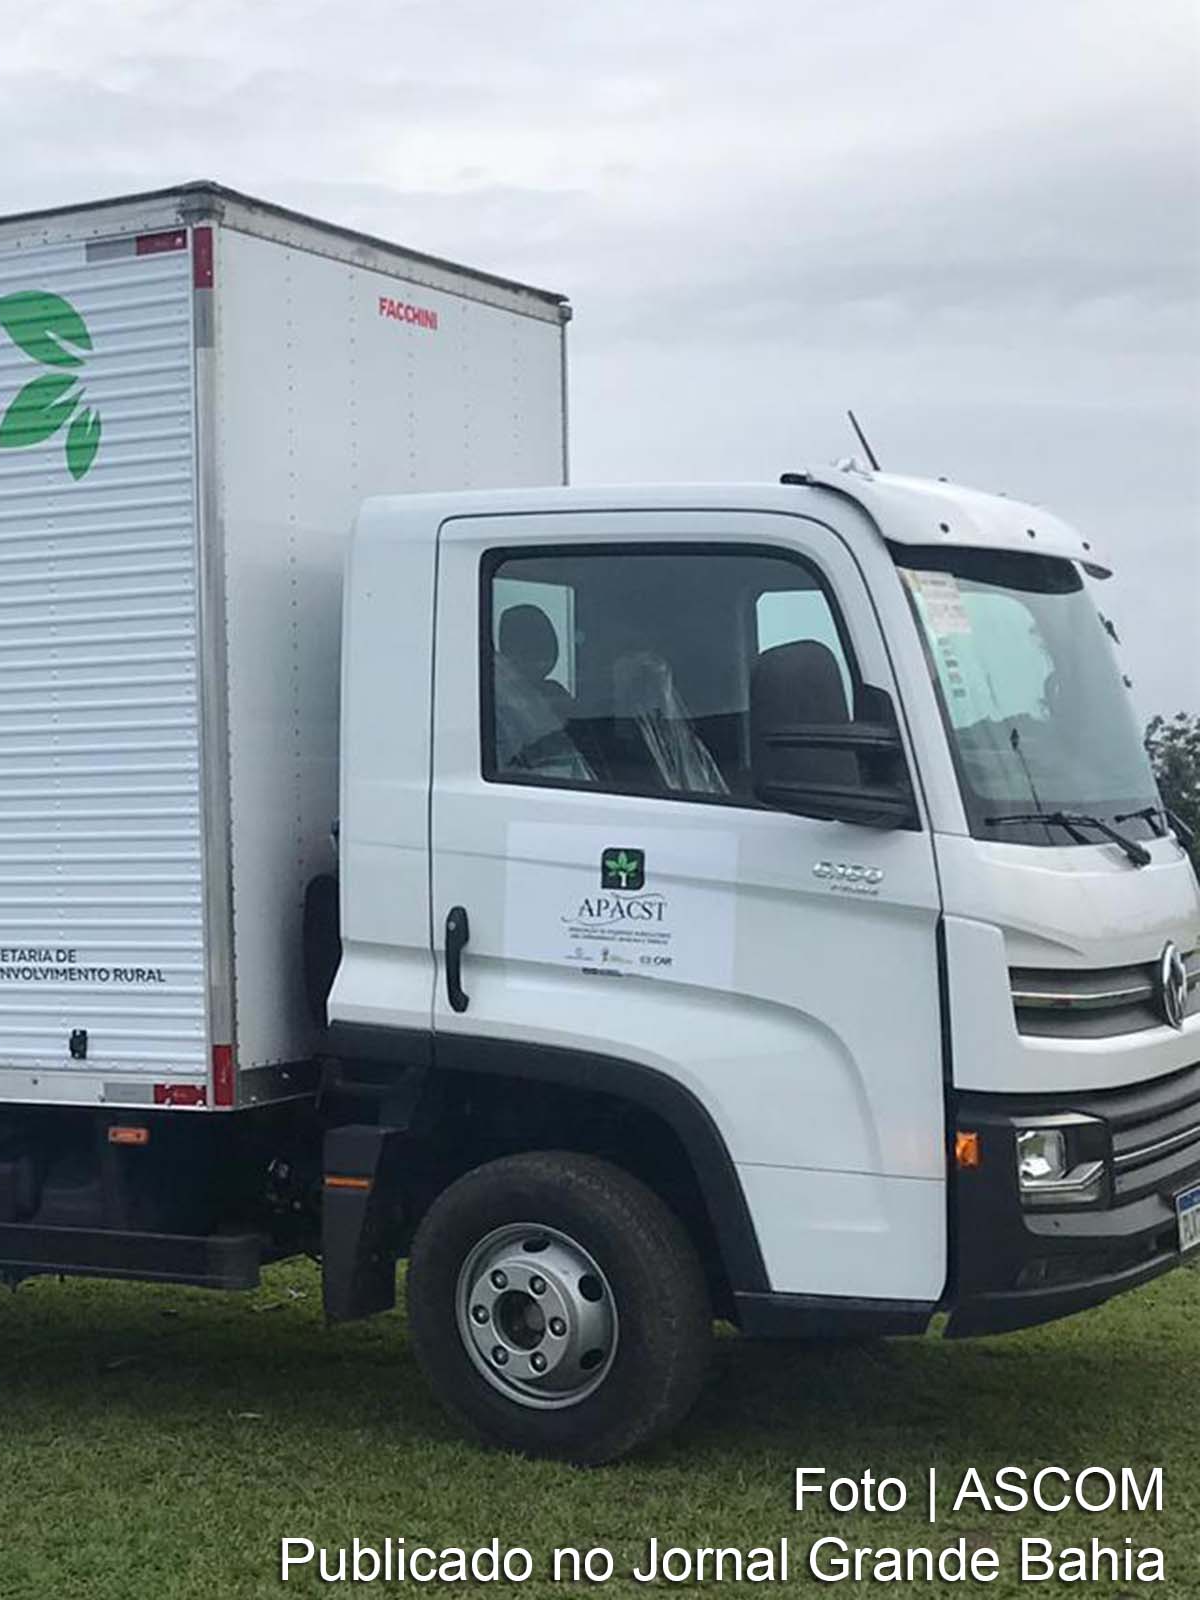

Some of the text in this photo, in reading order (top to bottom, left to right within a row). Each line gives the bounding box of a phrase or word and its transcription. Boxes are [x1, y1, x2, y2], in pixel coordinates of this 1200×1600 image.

[378, 297, 438, 330] FACCHINI
[573, 896, 668, 922] APACST
[55, 949, 78, 964] DE
[113, 967, 167, 984] RURAL
